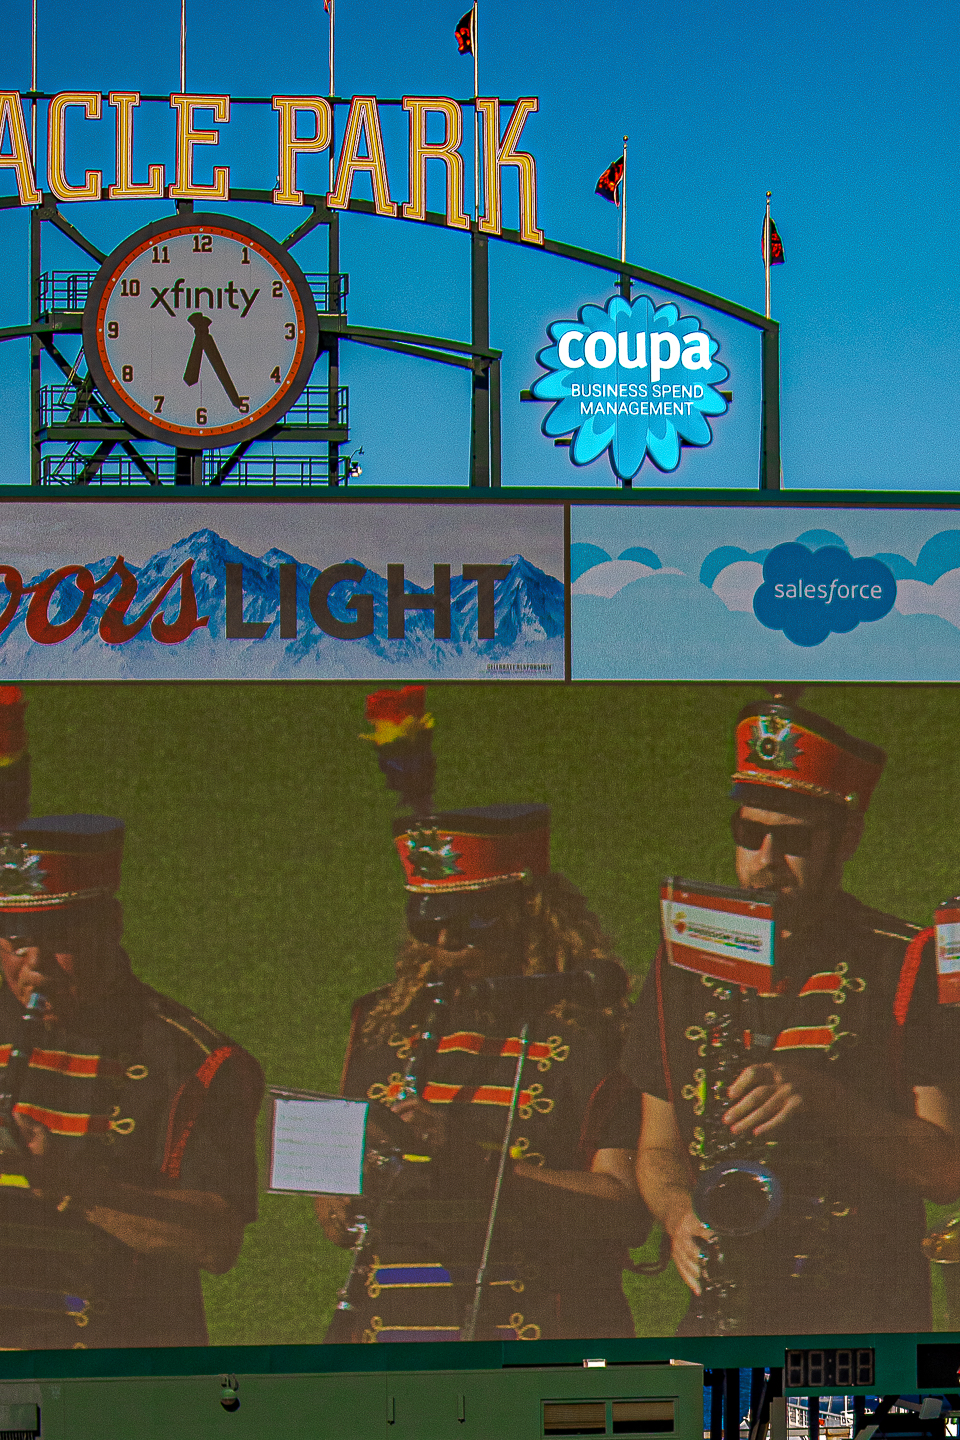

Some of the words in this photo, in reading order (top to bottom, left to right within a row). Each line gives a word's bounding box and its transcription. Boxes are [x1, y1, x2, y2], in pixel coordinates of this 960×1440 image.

[272, 94, 544, 246] PARK
[193, 235, 213, 254] 12
[151, 246, 170, 264] 11
[240, 247, 250, 264] 1
[120, 279, 140, 297] 10
[272, 281, 283, 298] 2
[150, 278, 260, 318] xfinity
[108, 322, 119, 339] 9
[284, 323, 296, 340] 3
[558, 330, 712, 382] coupa
[121, 366, 134, 383] 8
[270, 367, 281, 384] 4
[571, 383, 647, 397] BUSINESS
[651, 384, 704, 399] SPEND
[154, 396, 164, 413] 7
[239, 397, 250, 414] 5
[580, 401, 694, 416] MANAGEMENT
[196, 408, 207, 425] 6
[774, 579, 882, 604] salesforce
[225, 562, 512, 640] LIGHT
